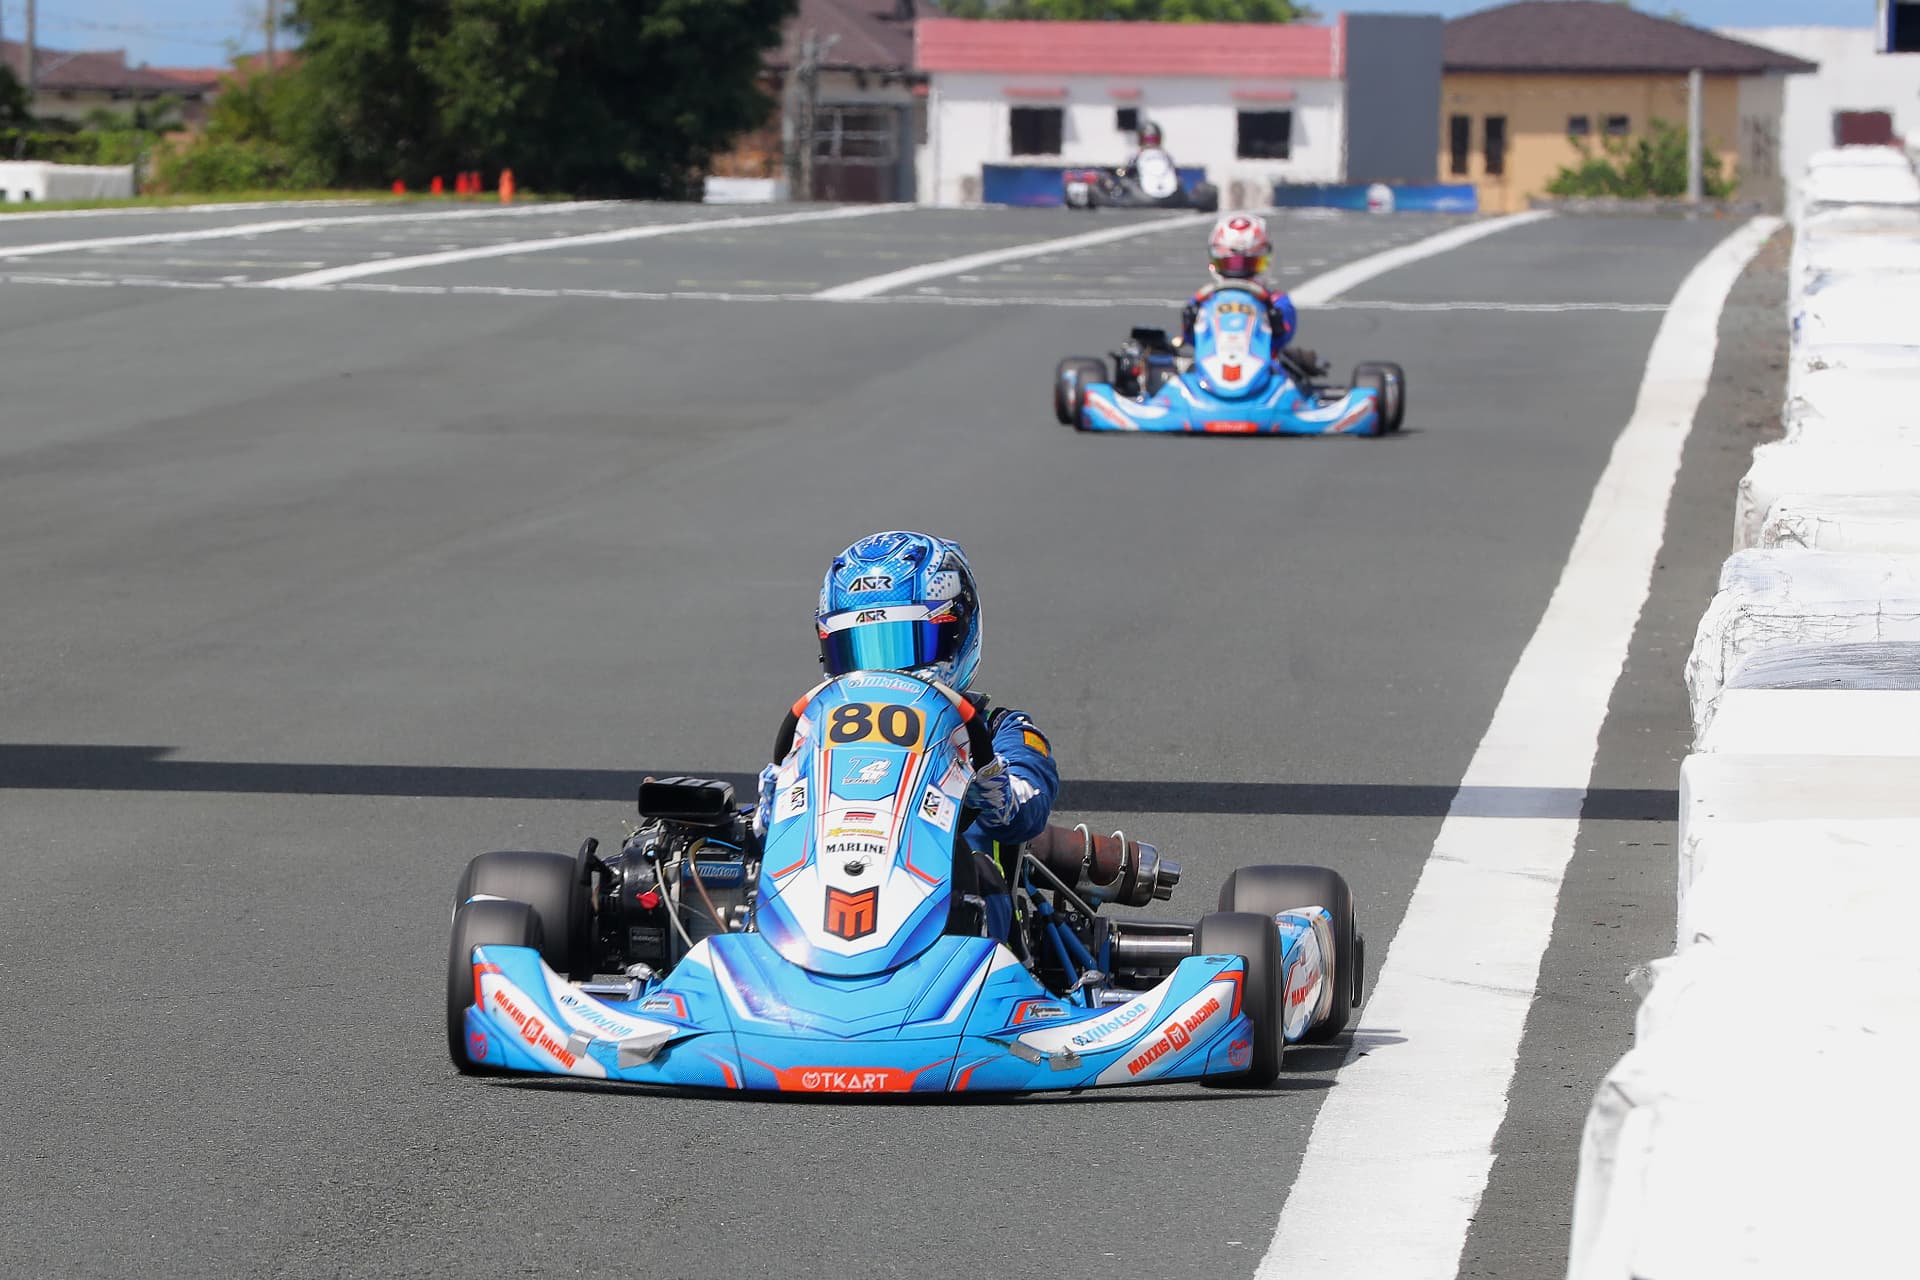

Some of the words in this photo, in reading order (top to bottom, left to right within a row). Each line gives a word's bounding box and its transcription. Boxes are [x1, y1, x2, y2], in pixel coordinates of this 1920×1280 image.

[829, 702, 921, 748] 80
[825, 841, 888, 856] MARLINE
[1083, 1002, 1147, 1041] Tillotson
[1127, 1038, 1171, 1076] MAXXIS
[1184, 997, 1220, 1032] RACING
